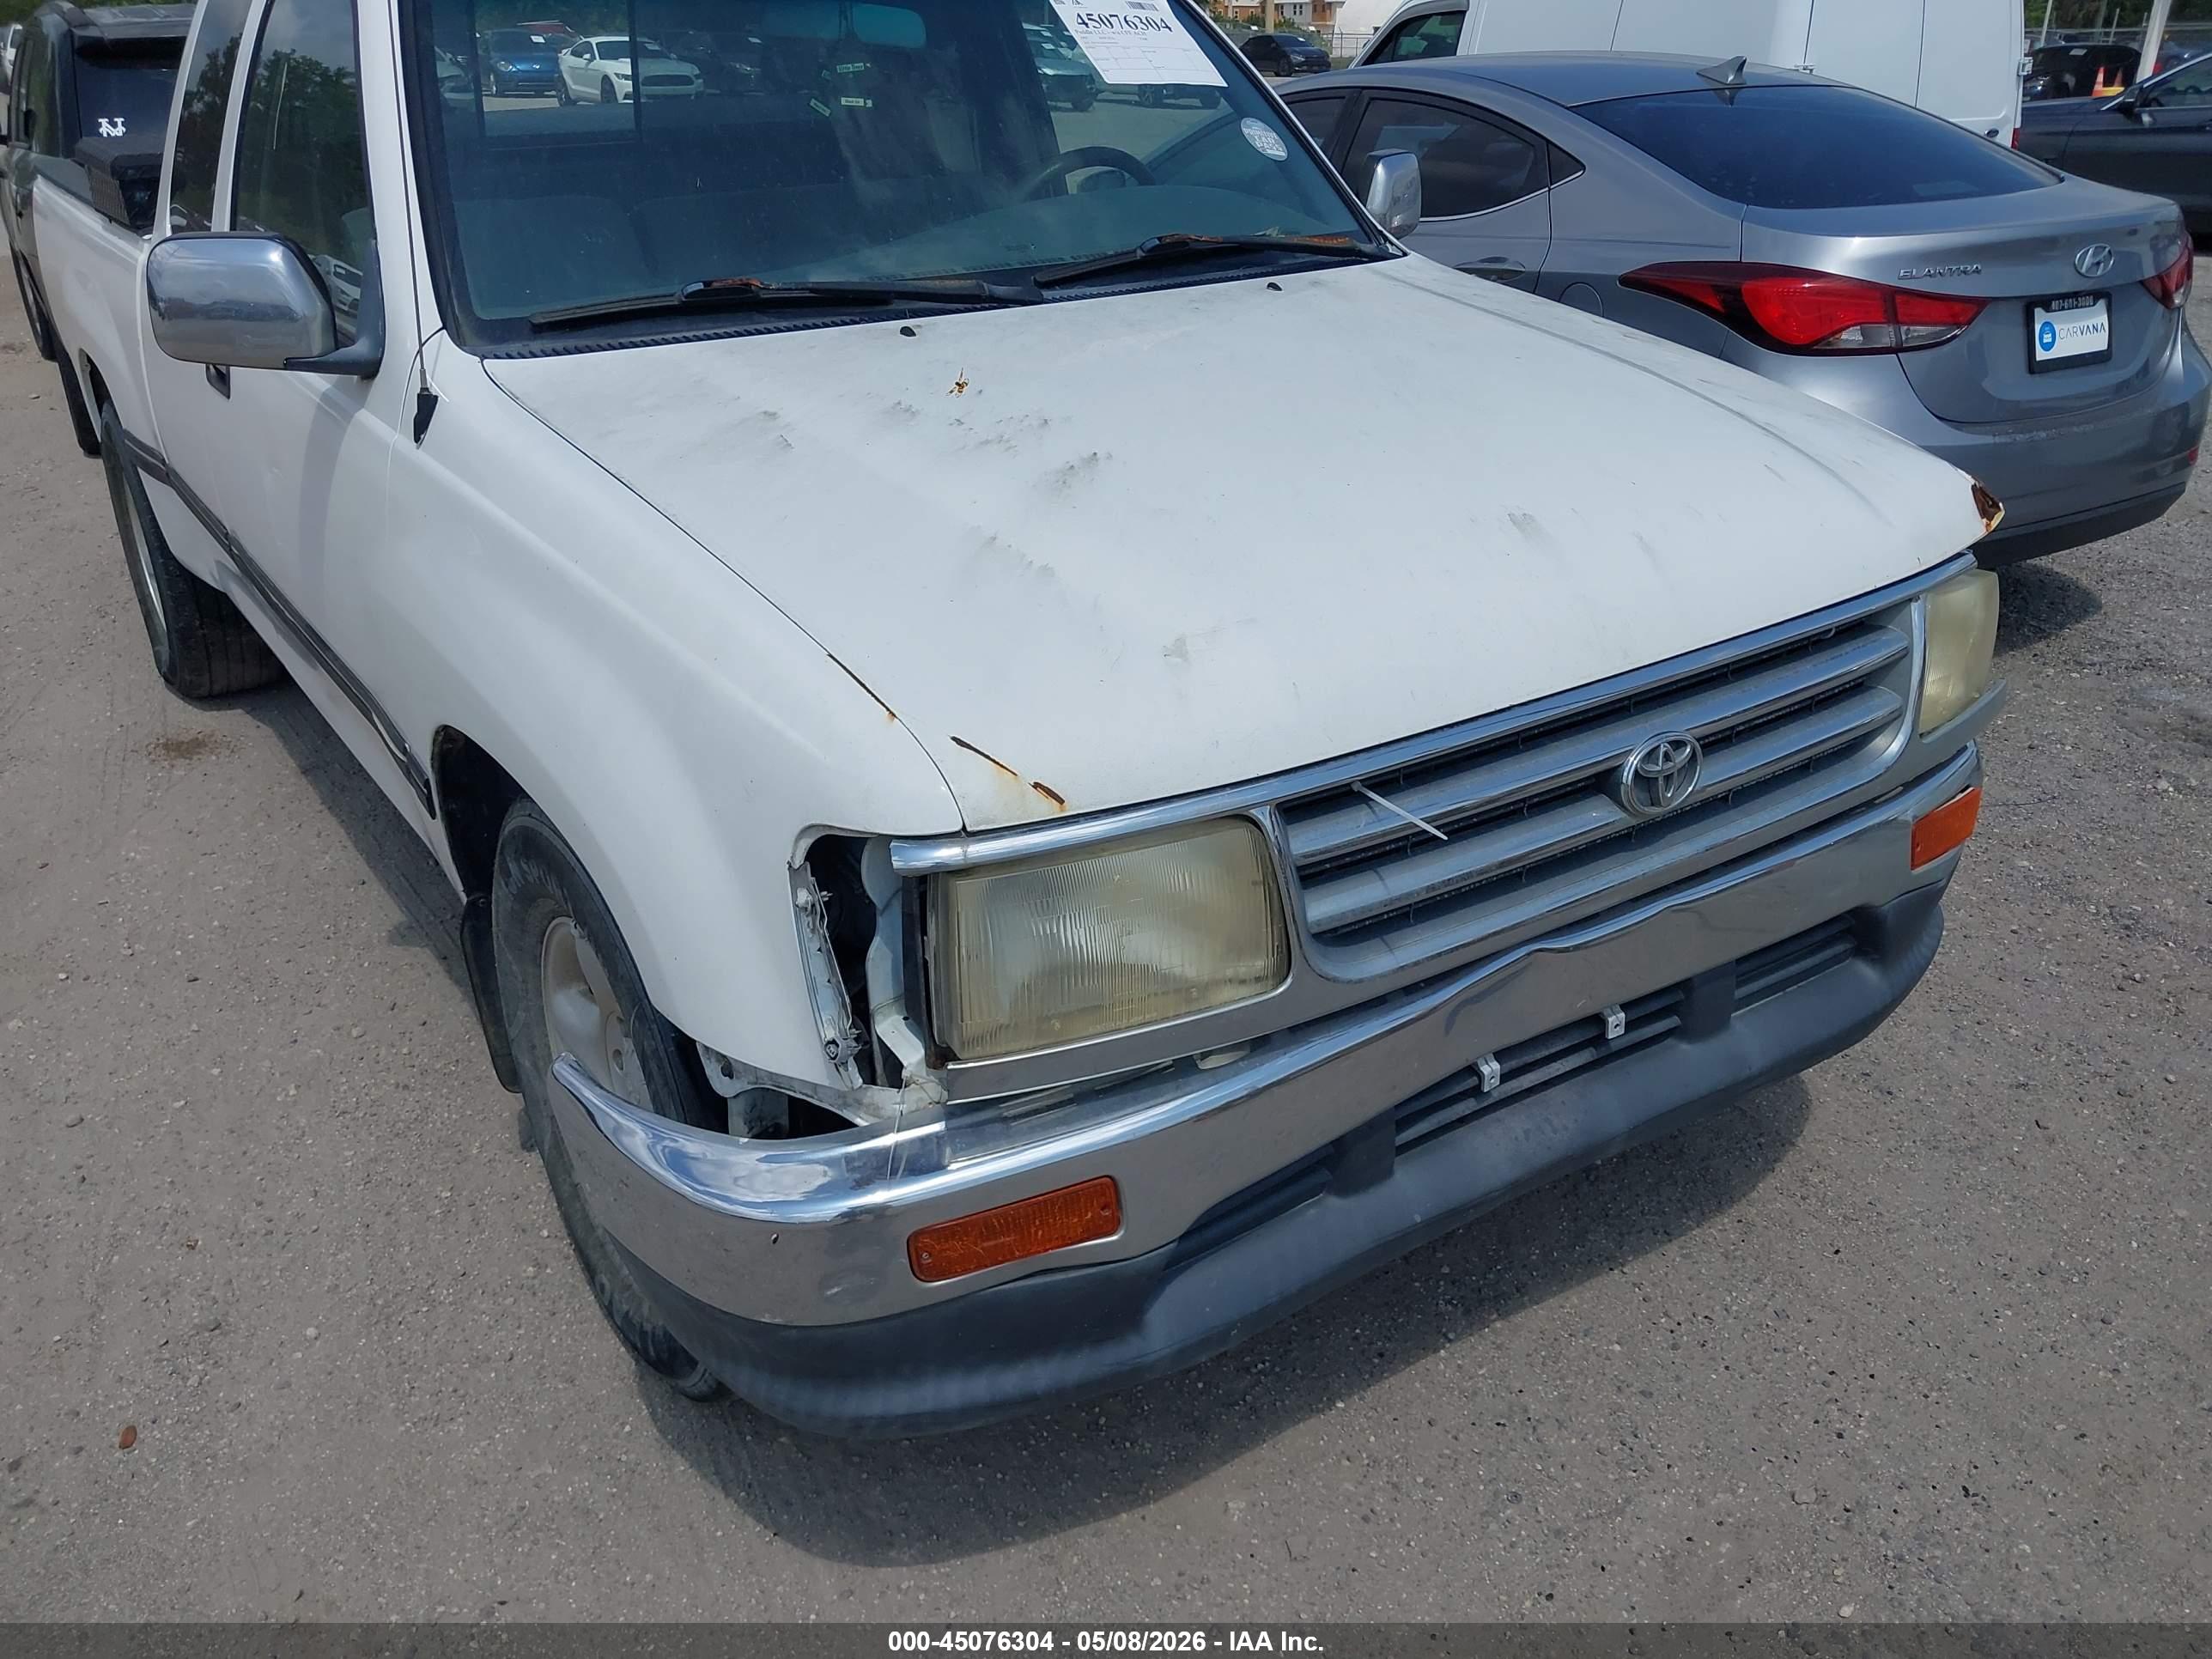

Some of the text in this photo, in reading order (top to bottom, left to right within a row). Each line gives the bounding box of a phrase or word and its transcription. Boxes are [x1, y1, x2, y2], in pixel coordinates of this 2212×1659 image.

[1076, 12, 1173, 33] 45076304
[1898, 264, 1982, 280] ELANTRA
[2058, 321, 2106, 340] CARVANA
